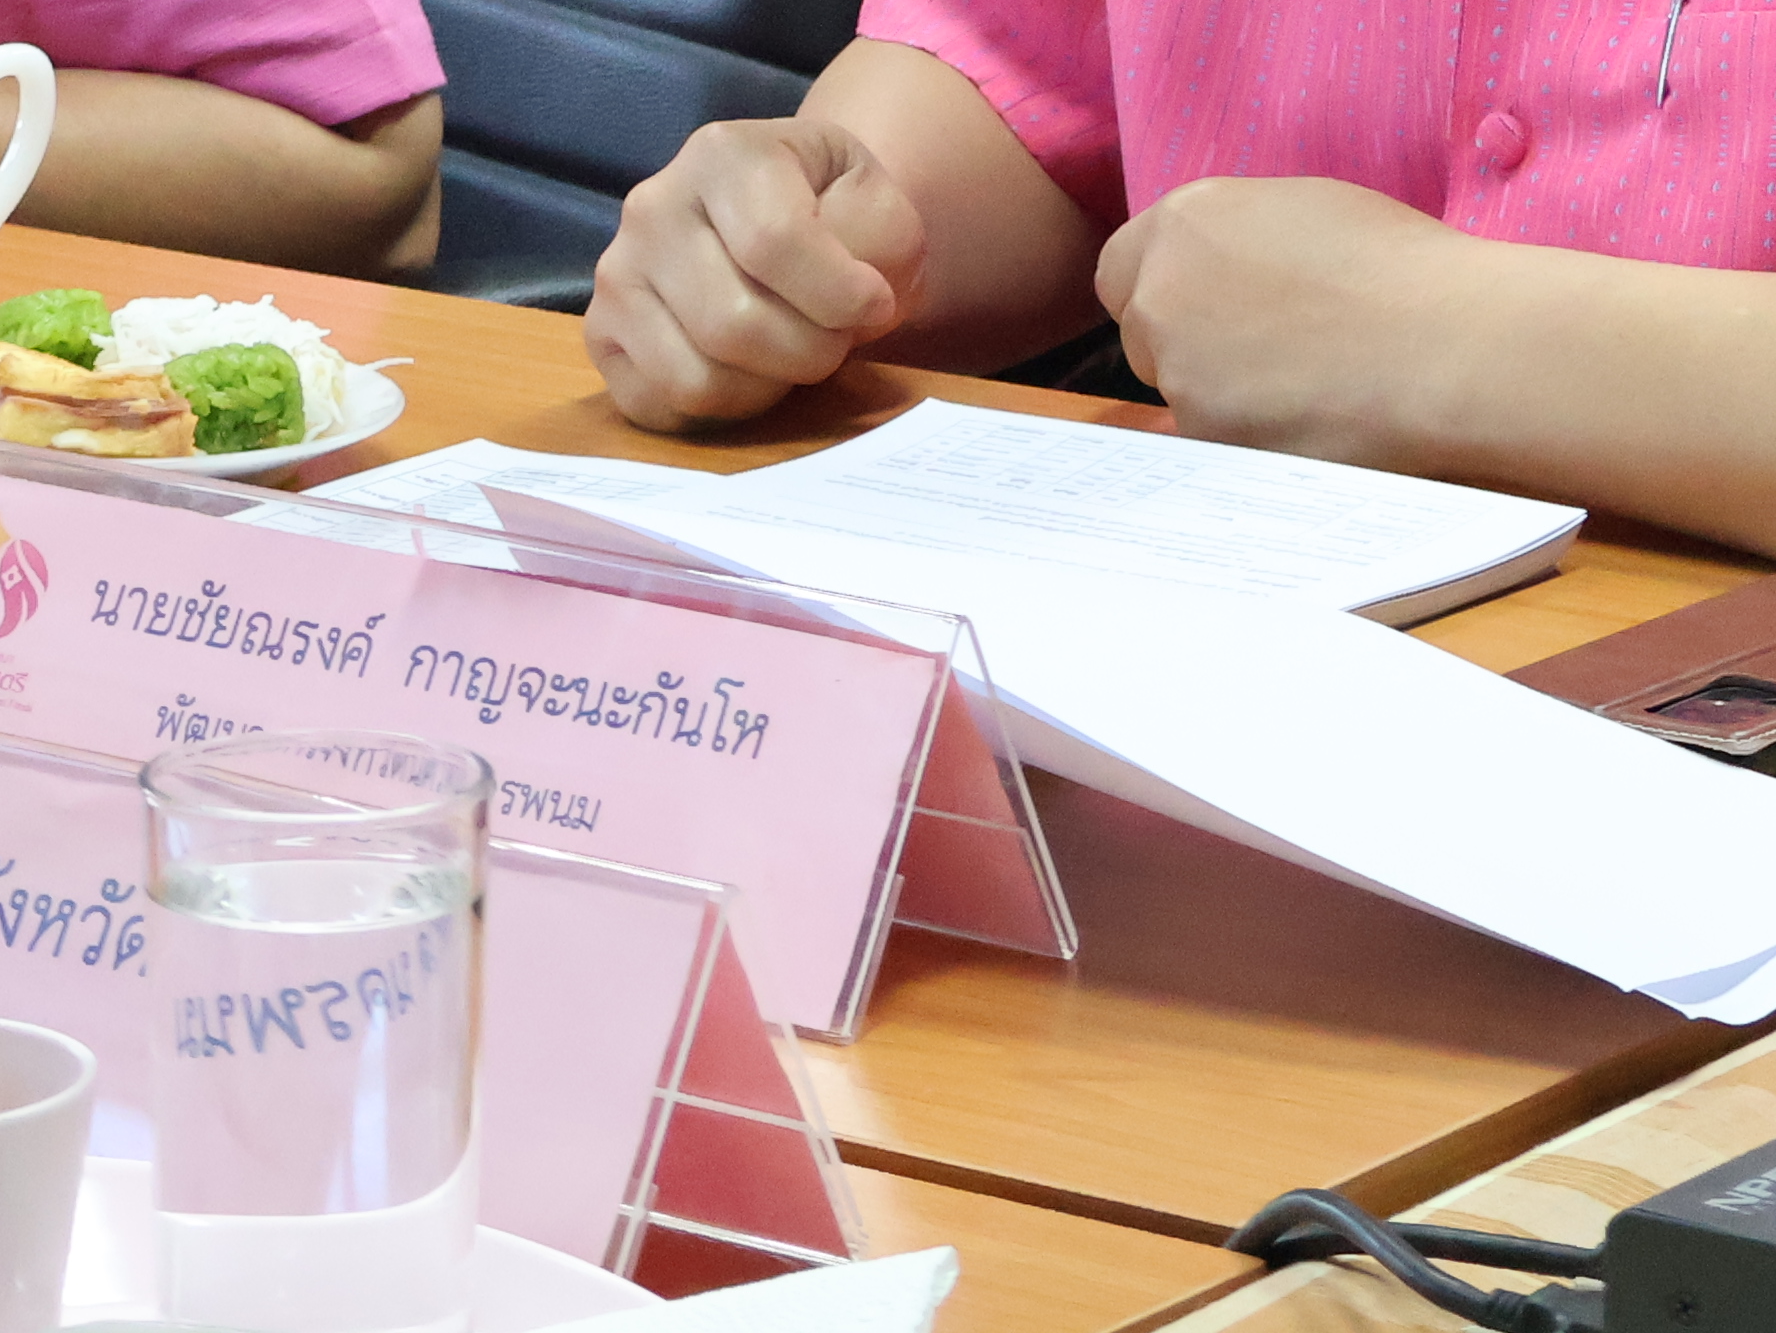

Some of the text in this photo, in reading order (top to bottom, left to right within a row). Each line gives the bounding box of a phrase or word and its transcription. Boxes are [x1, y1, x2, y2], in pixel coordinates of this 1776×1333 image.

[90, 579, 771, 760] นายชัยณรงค์ กาญจะนะกันโห
